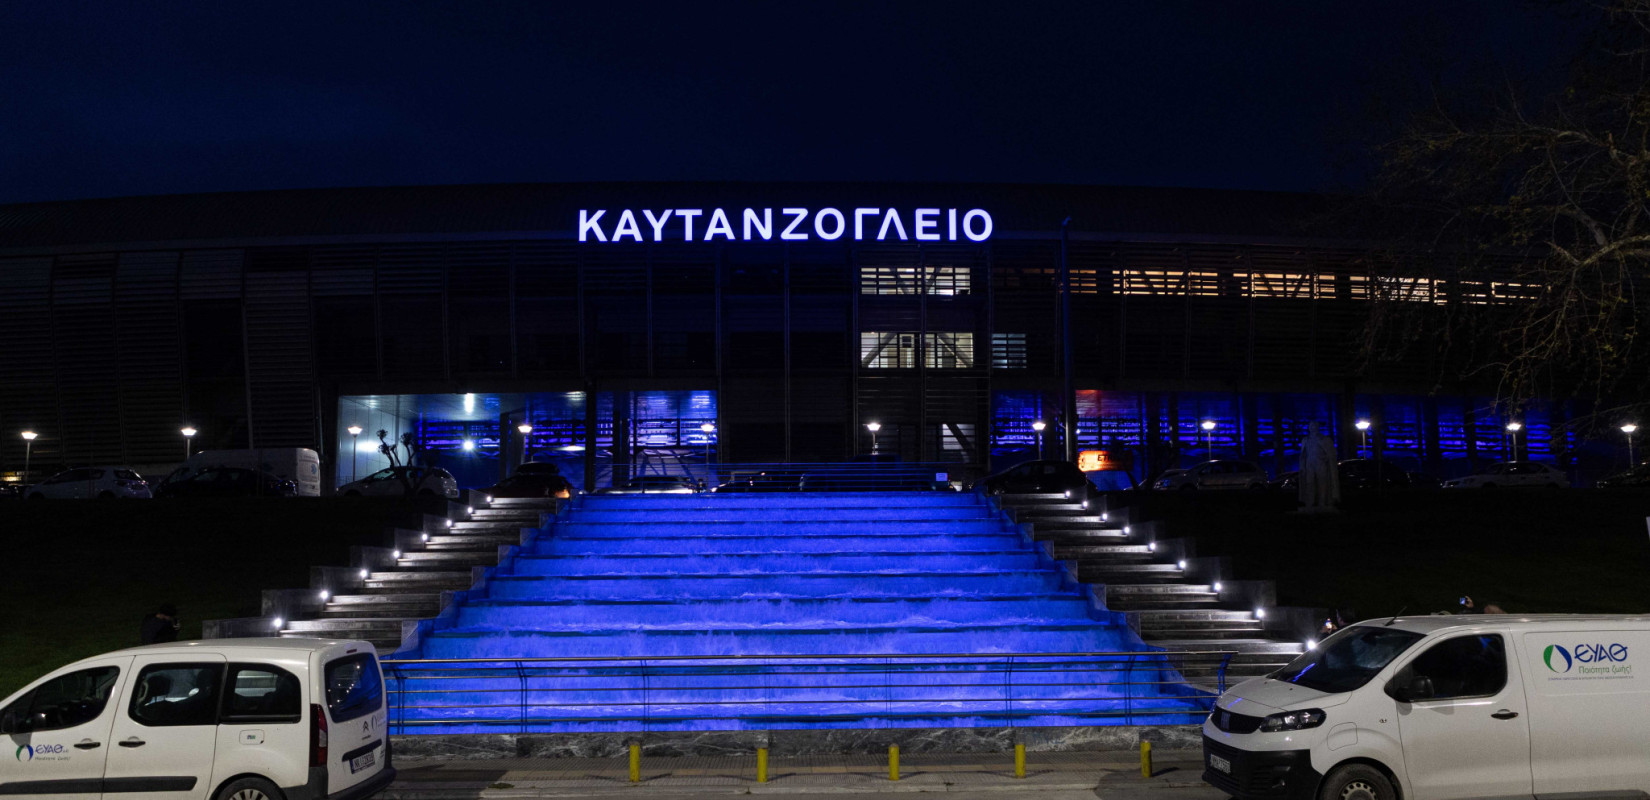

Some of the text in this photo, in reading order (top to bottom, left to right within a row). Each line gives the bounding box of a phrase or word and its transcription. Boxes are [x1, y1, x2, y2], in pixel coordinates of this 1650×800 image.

[579, 207, 993, 242] ΚΑΥΤΑΝΖΟΓΛΕΙΟ
[1574, 643, 1628, 663] ΕΥΑΘ
[1578, 665, 1610, 675] Ποιότητα
